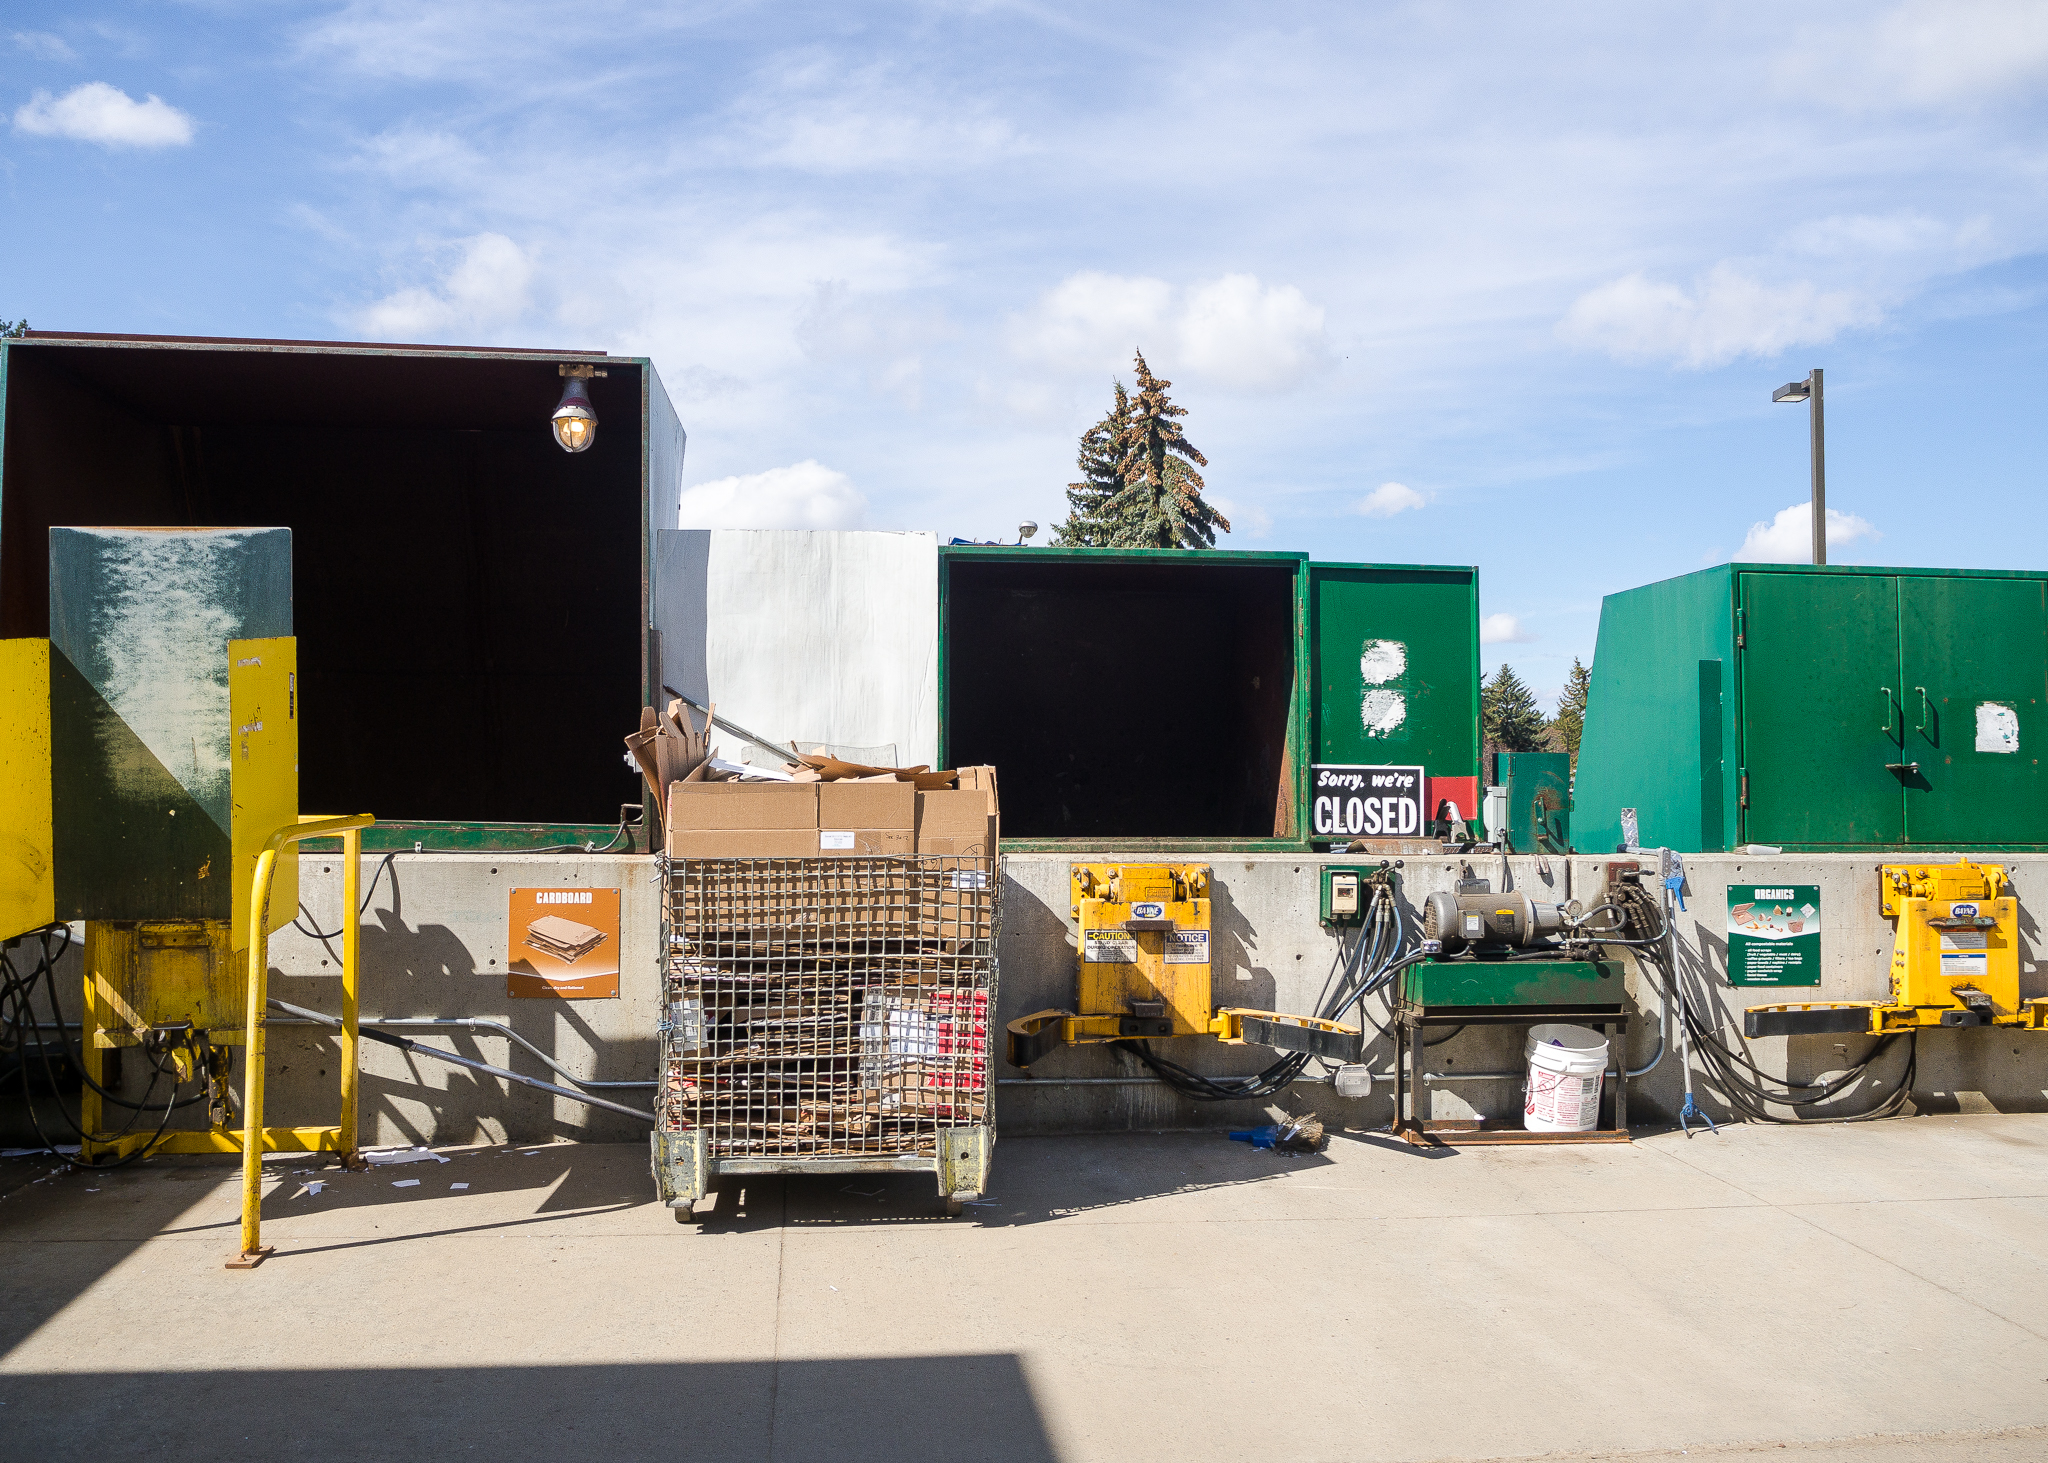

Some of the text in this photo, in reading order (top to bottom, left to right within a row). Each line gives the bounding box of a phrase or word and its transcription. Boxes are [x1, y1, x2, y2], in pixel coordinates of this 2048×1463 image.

[1372, 772, 1414, 787] we're
[1314, 796, 1418, 834] CLOSED
[536, 892, 592, 904] CARDBOARD
[1754, 889, 1794, 899] ORGANICS
[1136, 906, 1160, 914] BAYNE
[1093, 932, 1130, 940] CAUTION
[1169, 933, 1204, 942] NOTICE
